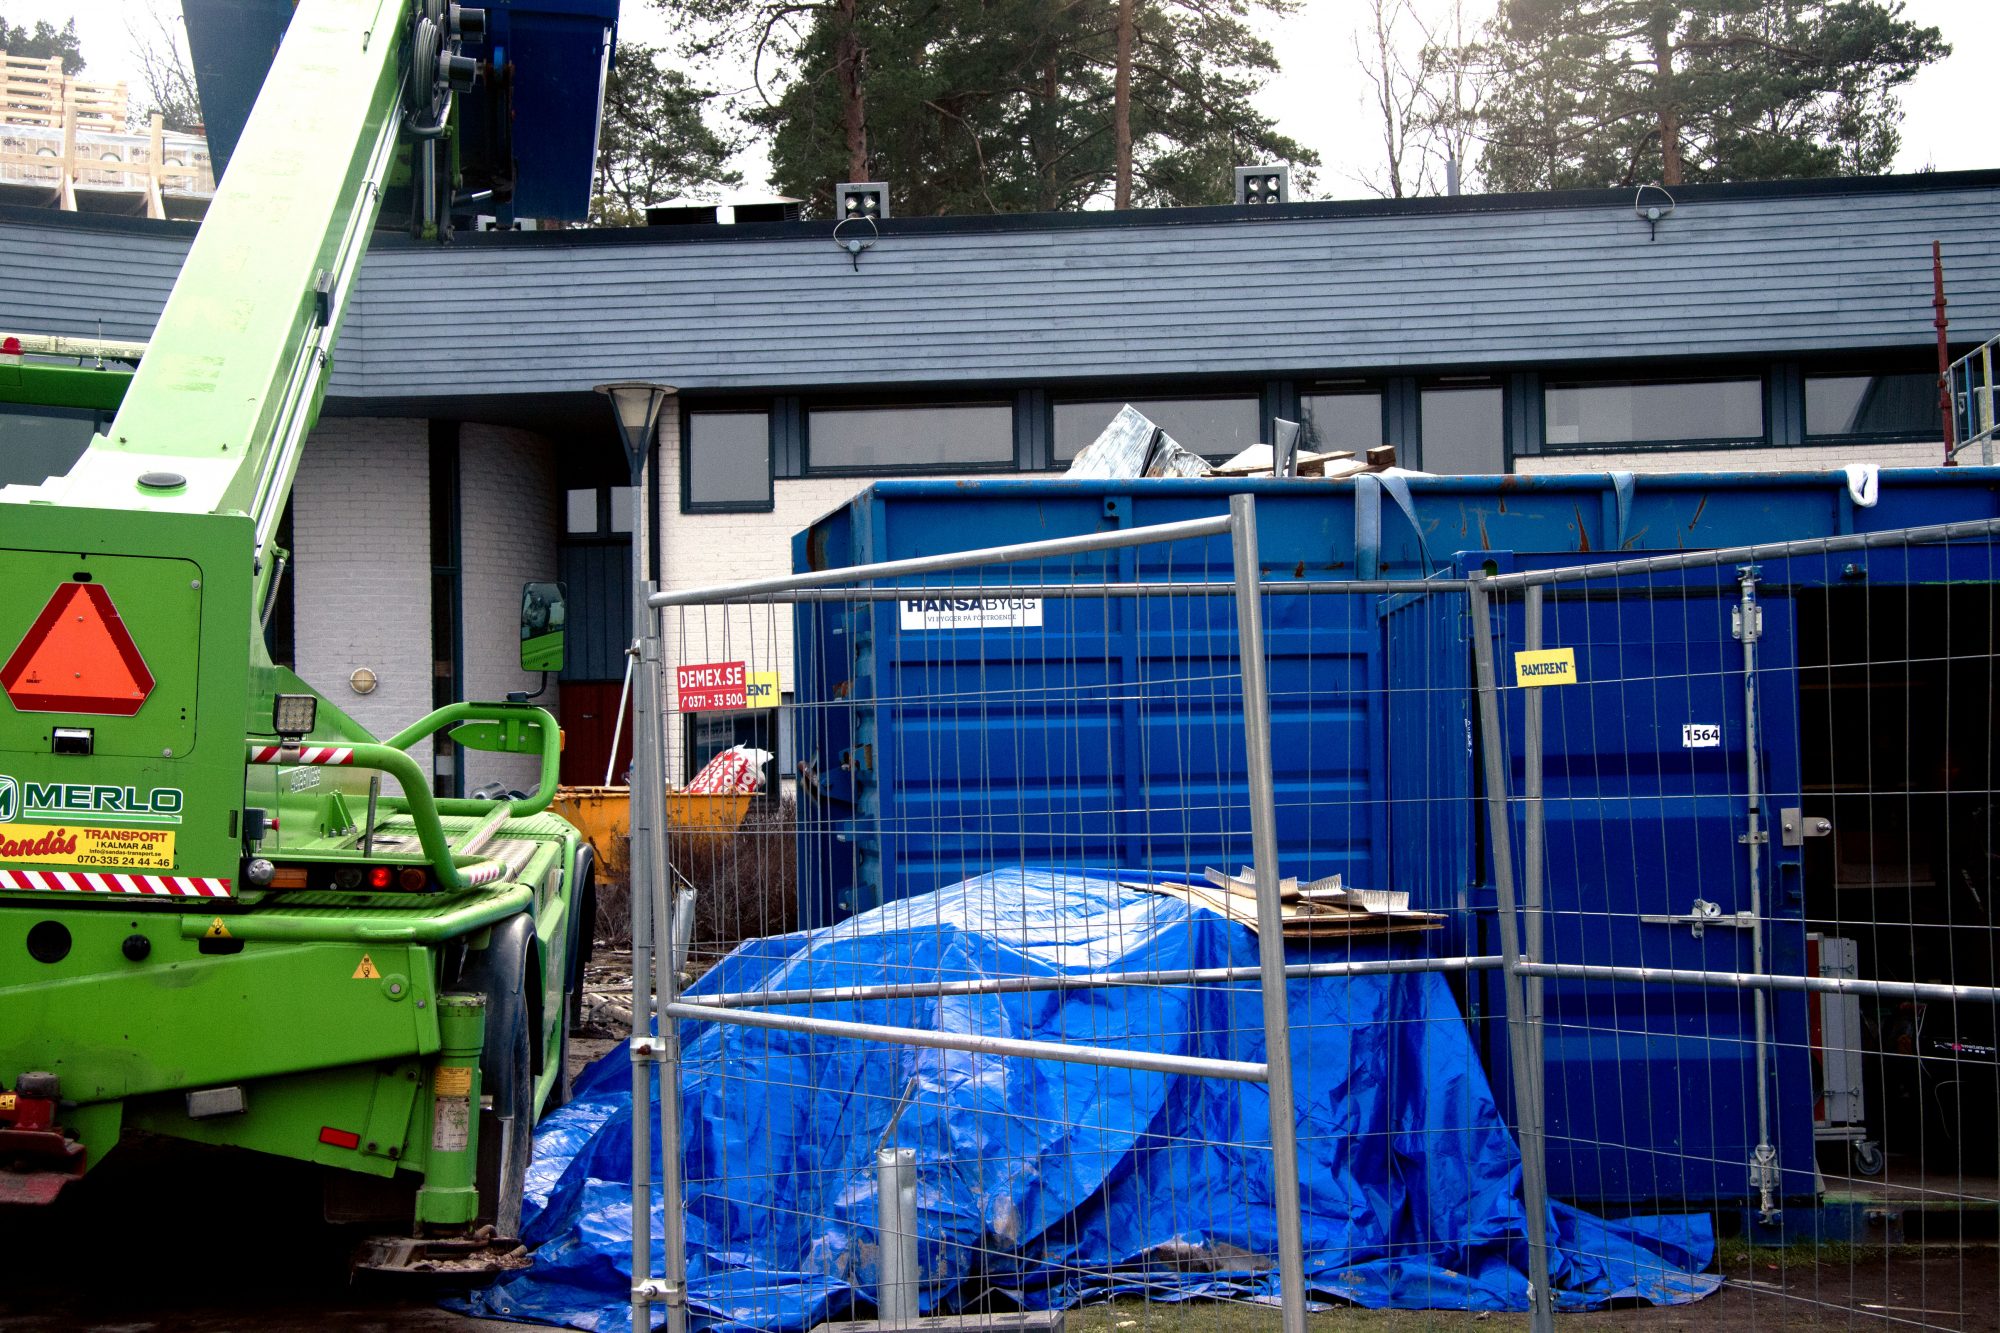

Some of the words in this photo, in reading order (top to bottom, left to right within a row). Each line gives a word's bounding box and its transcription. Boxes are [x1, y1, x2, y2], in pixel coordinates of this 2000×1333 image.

[907, 598, 1036, 612] HANSABYGG
[1521, 662, 1568, 676] RAMIRENT
[680, 666, 743, 689] DEMEX.SE
[688, 695, 706, 708] 0371
[713, 694, 724, 707] 33
[726, 693, 743, 705] 500
[1685, 729, 1719, 741] 1564
[24, 782, 183, 814] MERLO
[84, 829, 168, 843] TRANSPORT
[101, 841, 139, 850] KALMAR
[77, 855, 119, 865] 070-335
[122, 857, 135, 865] 24
[138, 857, 150, 866] 44
[153, 858, 170, 867] -46
